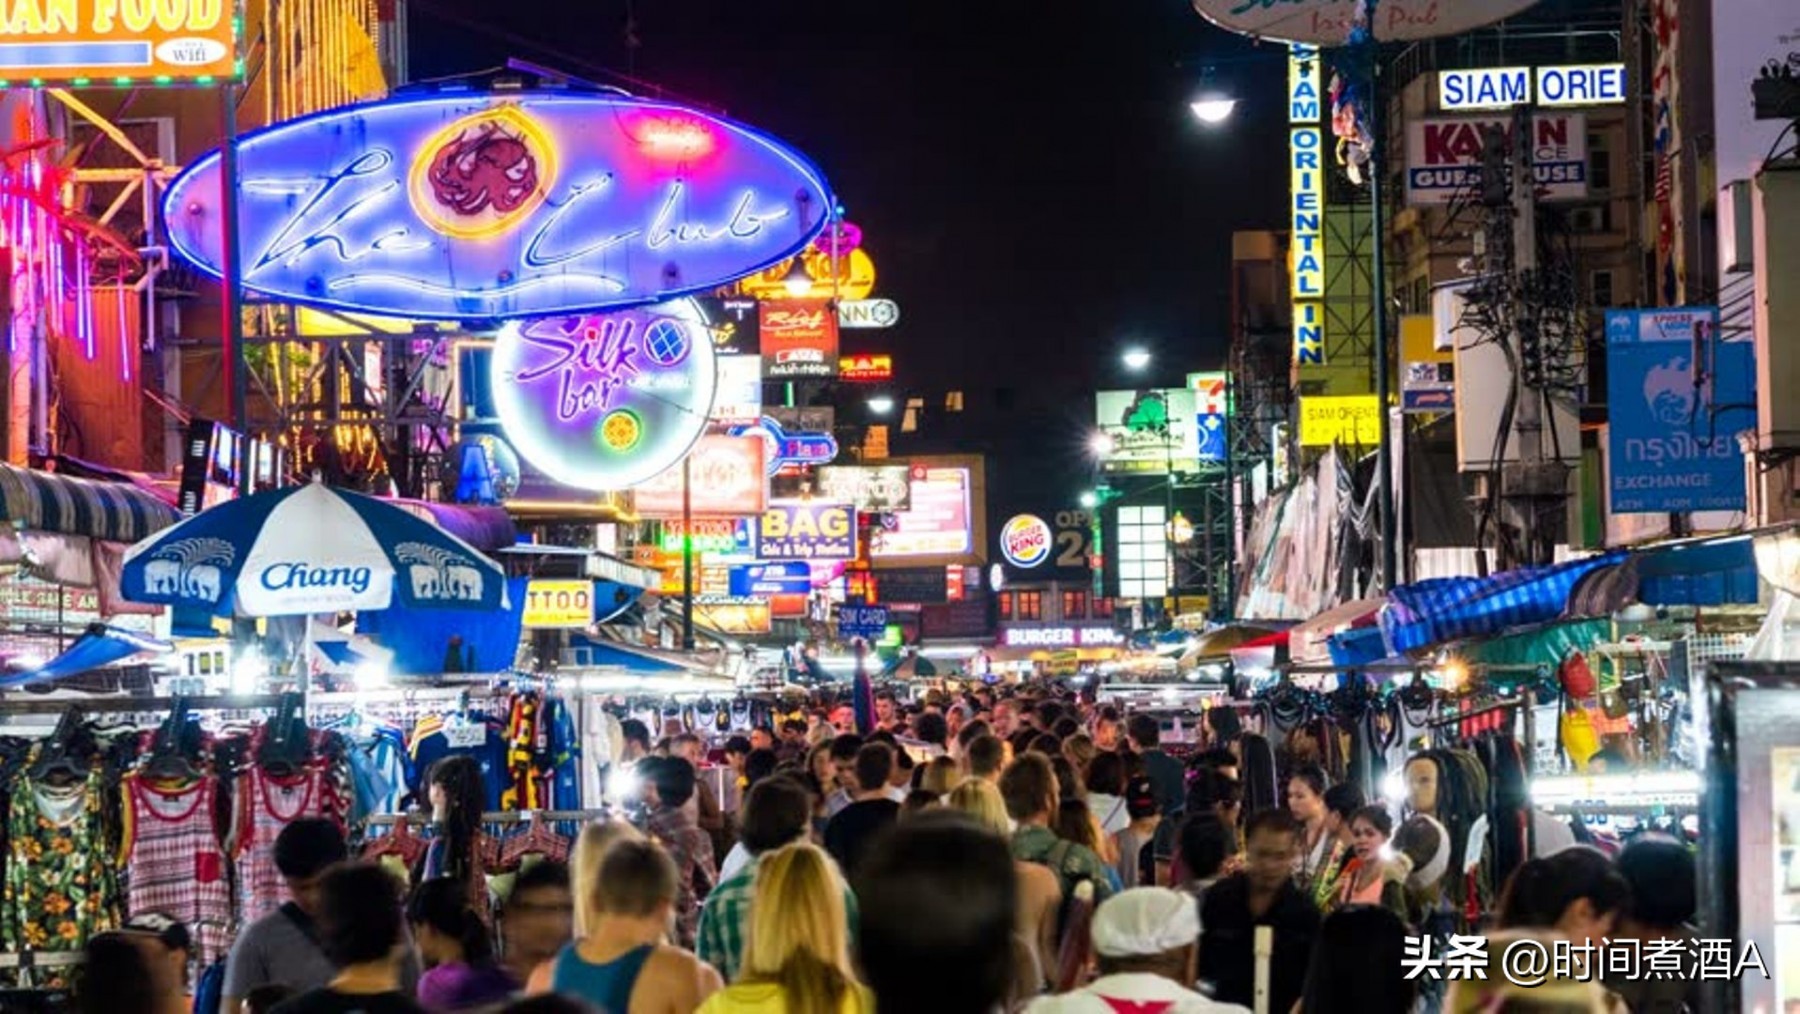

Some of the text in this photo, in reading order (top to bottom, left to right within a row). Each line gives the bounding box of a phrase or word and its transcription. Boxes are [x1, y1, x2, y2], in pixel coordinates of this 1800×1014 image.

[1445, 72, 1526, 104] SIAM
[241, 148, 790, 278] The Club
[1293, 130, 1320, 293] ORIENTAL
[518, 317, 640, 381] Silk
[1298, 306, 1322, 363] INN
[558, 366, 622, 421] bar
[1615, 474, 1713, 490] EXCHANGE
[762, 508, 850, 538] BAG
[1010, 533, 1045, 556] KING
[261, 562, 371, 593] Chang
[859, 608, 887, 625] CARD
[1006, 628, 1074, 646] BURGER
